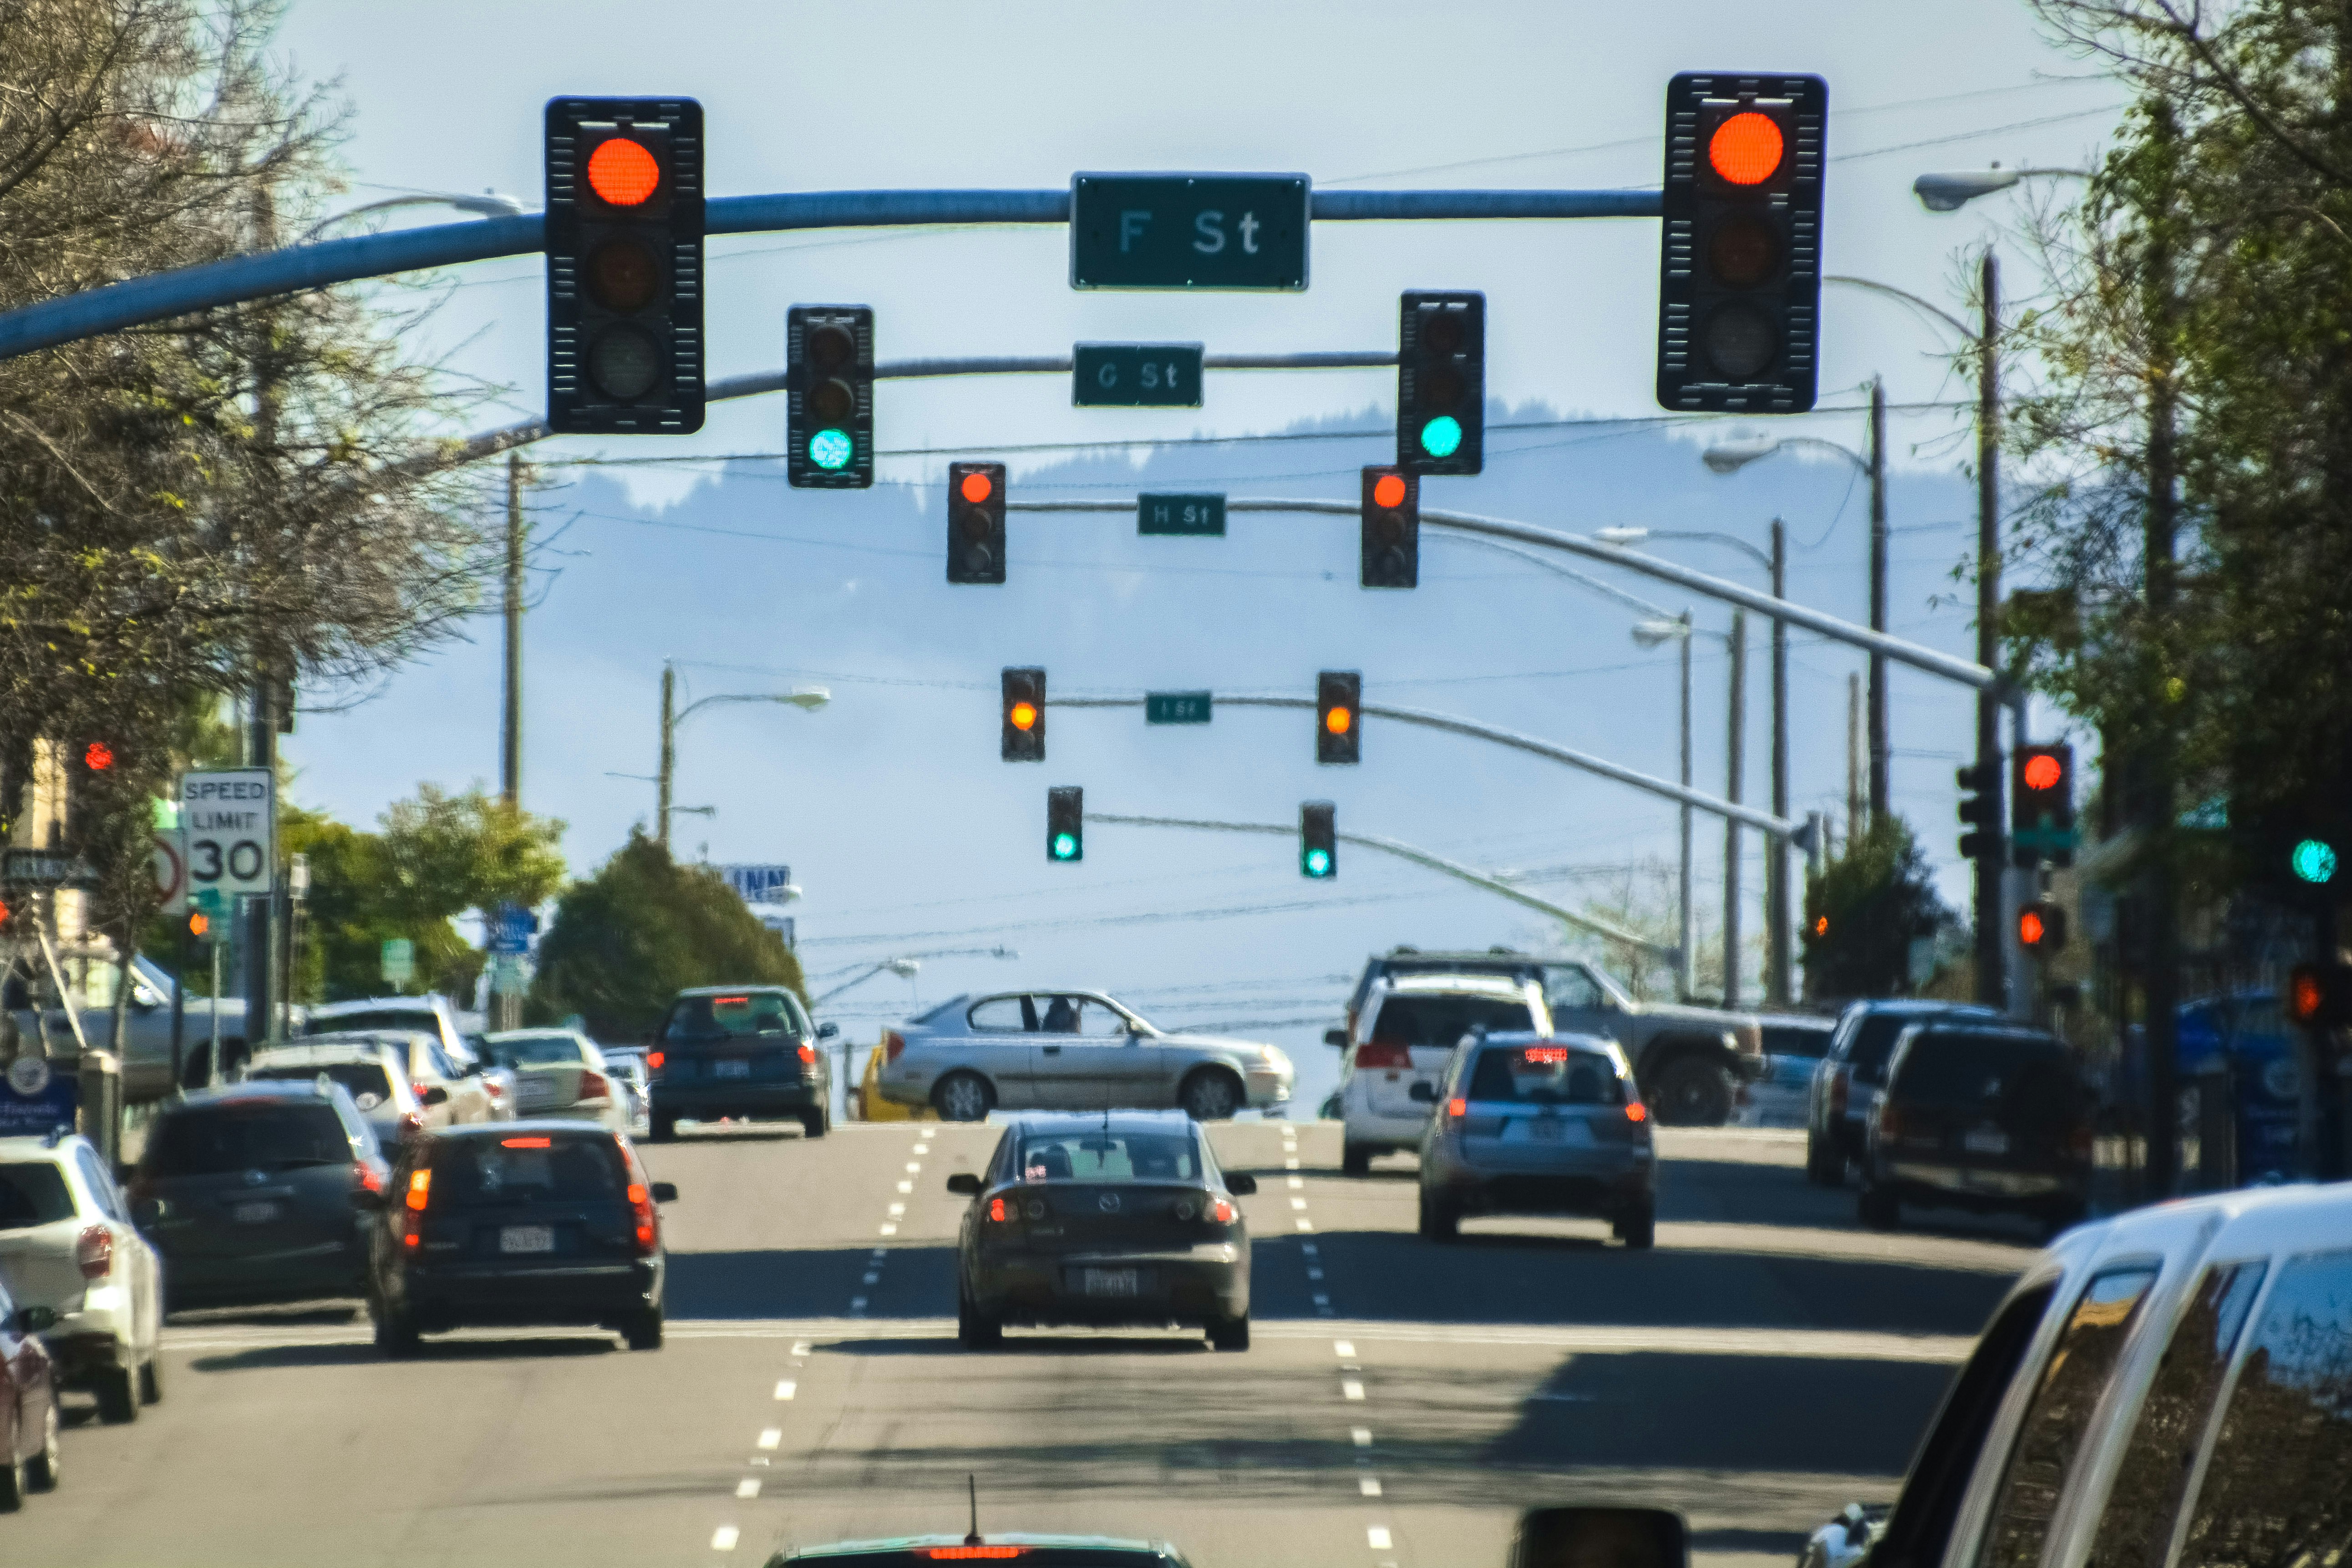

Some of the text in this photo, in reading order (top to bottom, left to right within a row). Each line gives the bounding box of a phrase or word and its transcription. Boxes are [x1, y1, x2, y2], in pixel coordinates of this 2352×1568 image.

[1119, 209, 1260, 255] F St
[1139, 362, 1178, 388] St
[1154, 504, 1209, 523] H St
[185, 781, 264, 800] SPEED
[191, 812, 258, 830] LIMIT
[192, 839, 263, 882] 30
